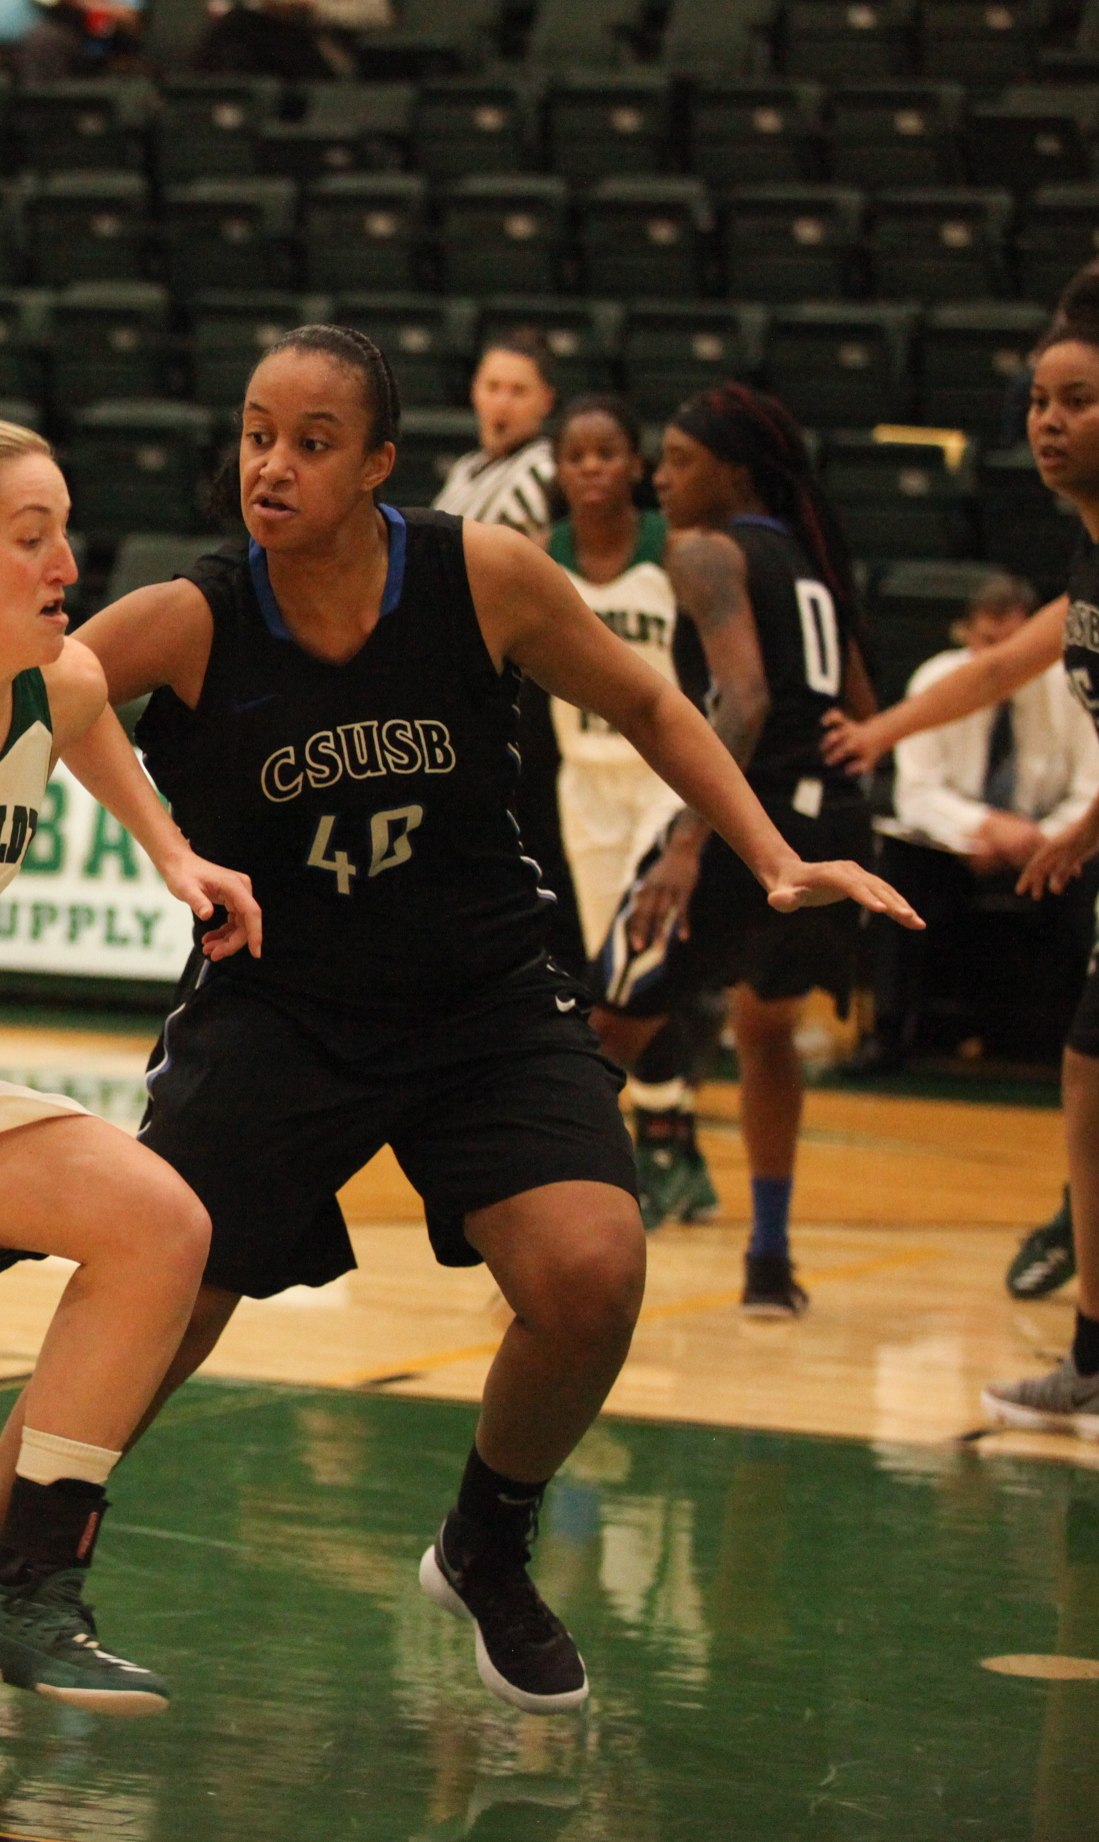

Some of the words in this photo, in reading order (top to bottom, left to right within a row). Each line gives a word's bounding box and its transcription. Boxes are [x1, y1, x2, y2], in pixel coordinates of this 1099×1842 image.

[795, 578, 840, 697] 0
[261, 719, 456, 802] CSUSB
[306, 804, 424, 895] 40
